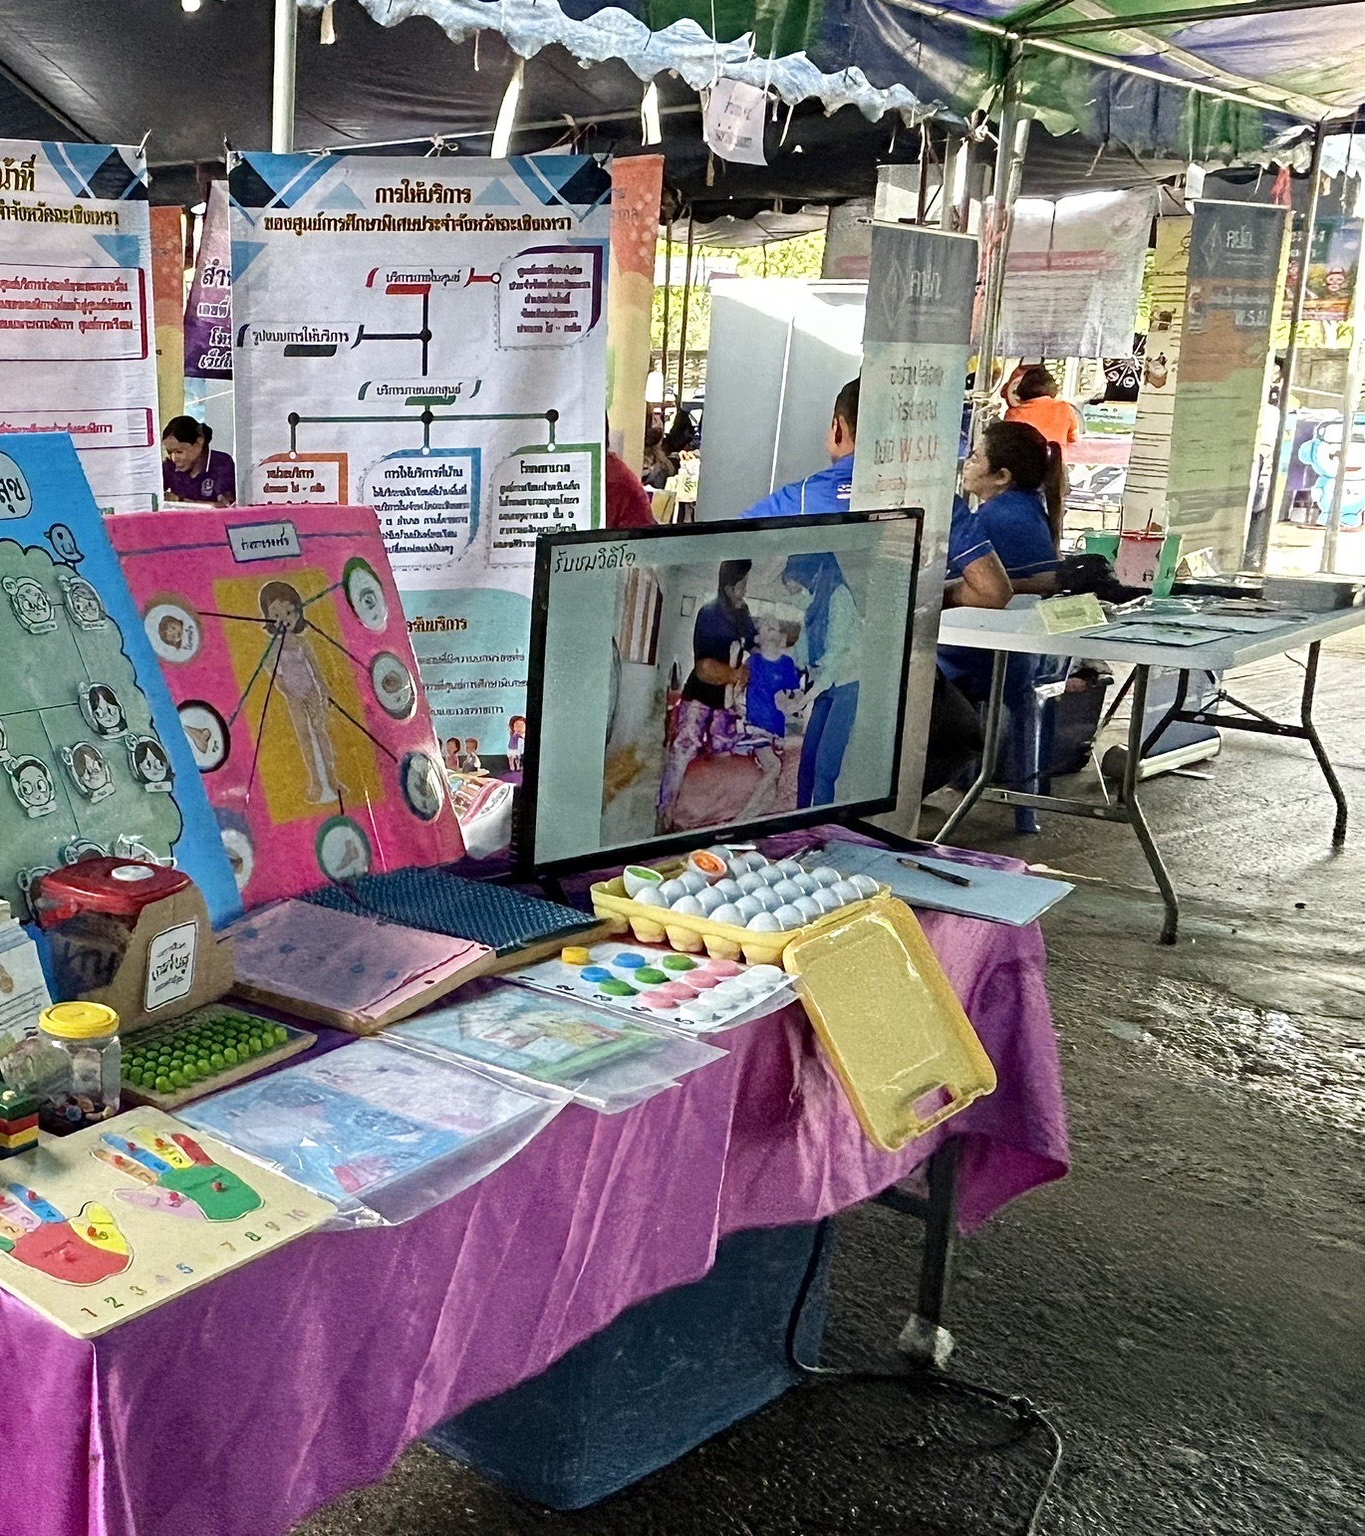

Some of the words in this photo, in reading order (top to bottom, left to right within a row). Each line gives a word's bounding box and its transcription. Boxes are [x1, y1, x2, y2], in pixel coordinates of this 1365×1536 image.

[375, 178, 471, 204] การให้บริการ
[263, 211, 572, 237] ของศูนย์การศึกษาพิเศษประจำจังหวัดฉะเชิงเทรา
[81, 1306, 98, 1318] 1
[104, 1296, 125, 1309] 2
